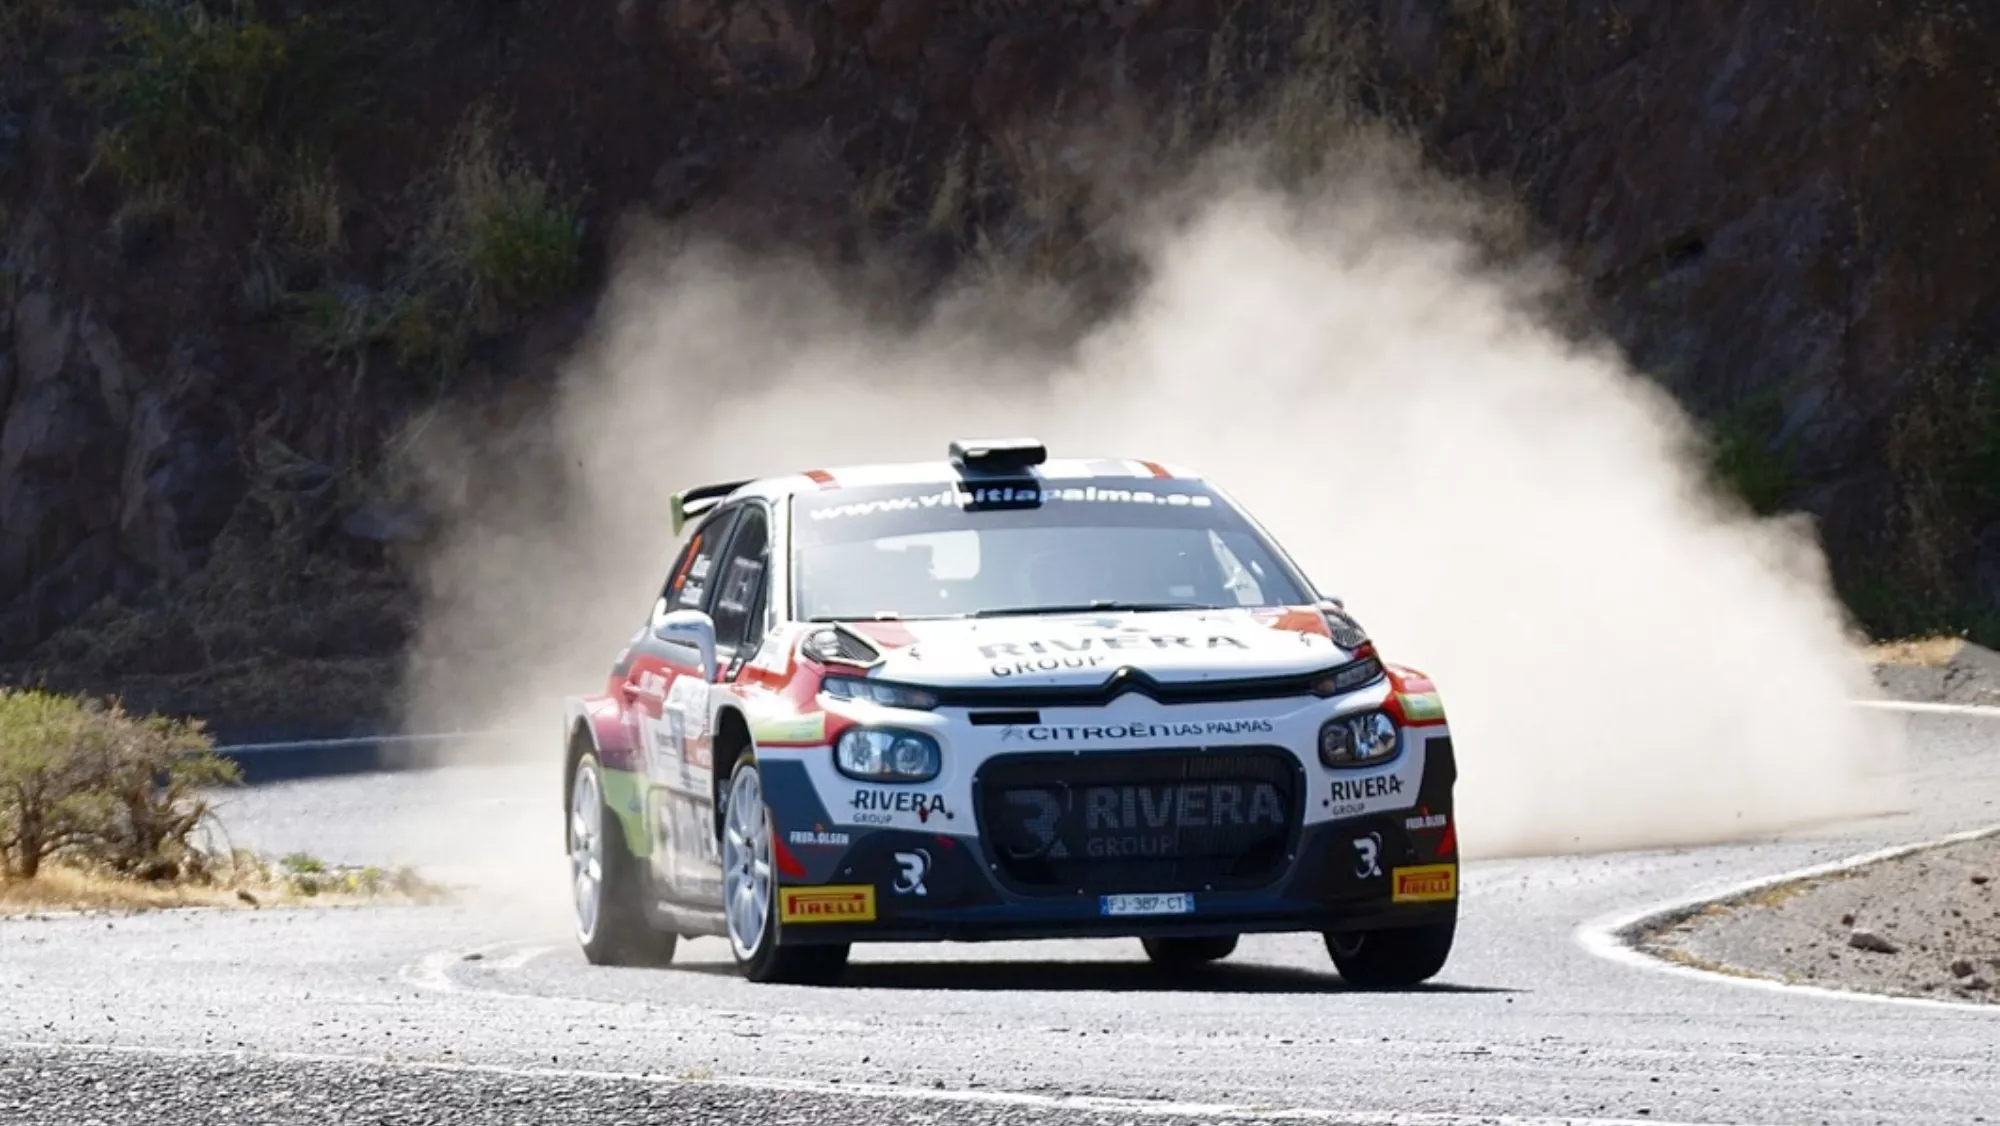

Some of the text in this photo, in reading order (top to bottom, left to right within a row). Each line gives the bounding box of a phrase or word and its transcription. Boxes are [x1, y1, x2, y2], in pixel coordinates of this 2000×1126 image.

[979, 636, 1251, 658] RIVERA
[990, 655, 1104, 677] GROUP
[1173, 723, 1203, 736] LAS
[1206, 720, 1273, 734] PALMAS
[1331, 774, 1402, 801] RIVERA
[853, 789, 946, 814] RIVERA
[1085, 781, 1284, 829] RIVERA
[1332, 803, 1365, 816] GROUP
[852, 812, 893, 824] GROUP
[1087, 835, 1175, 857] GROUP
[1398, 871, 1450, 895] PIRELLI
[788, 893, 865, 915] PIRELLI
